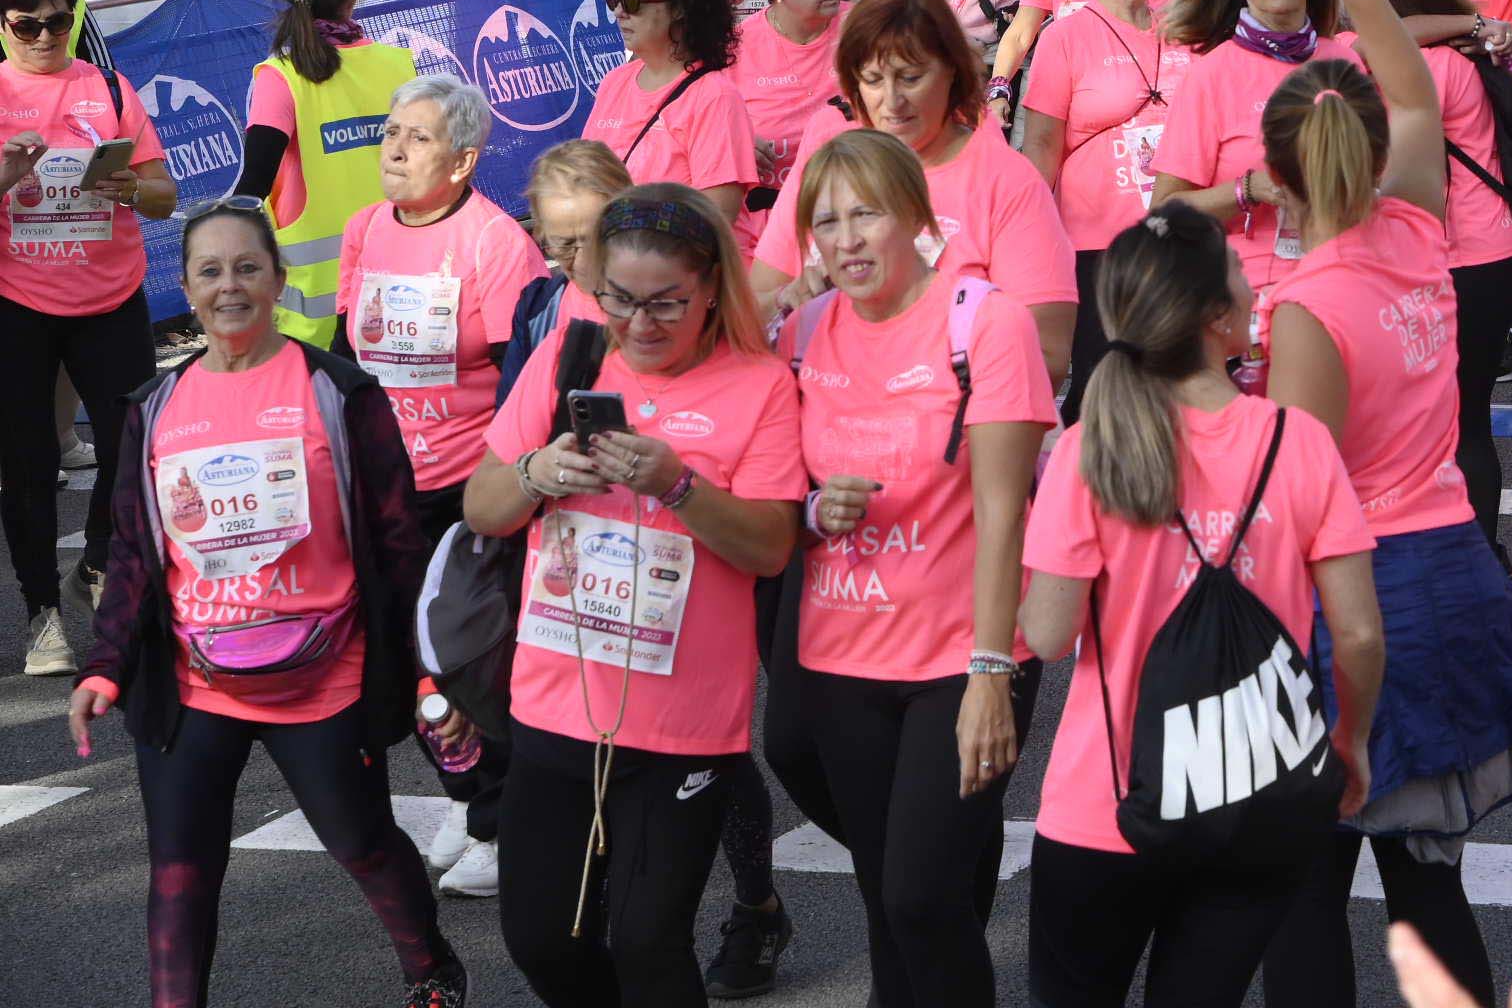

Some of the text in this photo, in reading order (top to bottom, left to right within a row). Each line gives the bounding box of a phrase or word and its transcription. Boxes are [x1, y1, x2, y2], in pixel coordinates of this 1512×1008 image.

[483, 56, 575, 105] ASTURIANA
[164, 131, 239, 182] URIANA
[46, 185, 81, 200] 016
[55, 202, 71, 211] 434
[20, 227, 53, 236] OYSHO
[8, 240, 87, 257] SUMA
[387, 319, 418, 337] 016
[201, 464, 258, 481] ASTURIANA
[210, 493, 258, 516] 016
[219, 518, 256, 533] 12982
[581, 572, 633, 600] 016
[810, 561, 889, 602] SUMA
[582, 599, 622, 617] 15840
[1160, 634, 1327, 821] NIKE
[684, 769, 713, 788] NIKE
